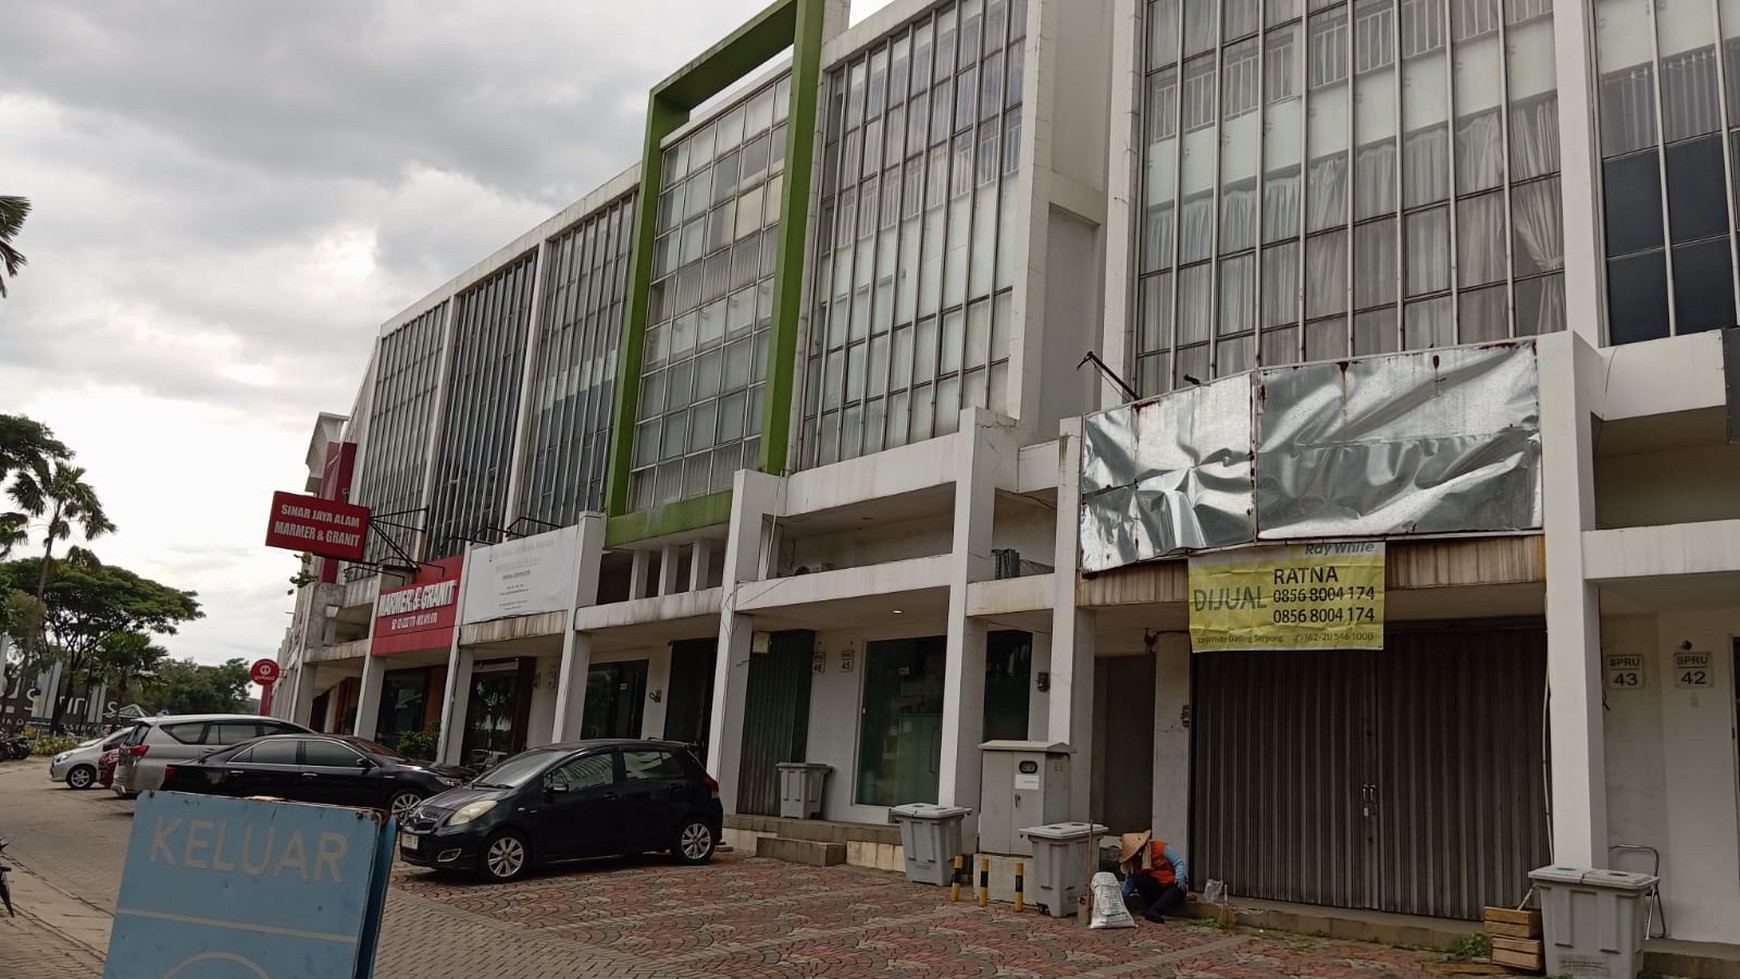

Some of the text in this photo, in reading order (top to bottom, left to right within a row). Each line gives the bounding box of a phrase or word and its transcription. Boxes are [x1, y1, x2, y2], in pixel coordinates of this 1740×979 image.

[311, 510, 333, 523] JAYA
[333, 513, 360, 527] ALAM
[274, 521, 361, 547] MARMER & GRANIT
[1305, 542, 1375, 556] Ray White
[1273, 566, 1339, 585] RATNA
[1193, 585, 1268, 612] DIJUAL
[1273, 586, 1375, 603] 0856 8004 174
[1273, 607, 1375, 624] 0856 8004 174
[1334, 632, 1351, 641] 546
[1352, 631, 1374, 641] 1000
[1609, 657, 1640, 667] SPRU
[1676, 655, 1709, 665] SPRU
[1613, 673, 1639, 687] 43
[1681, 671, 1707, 685] 42
[148, 812, 348, 884] KELUAR
